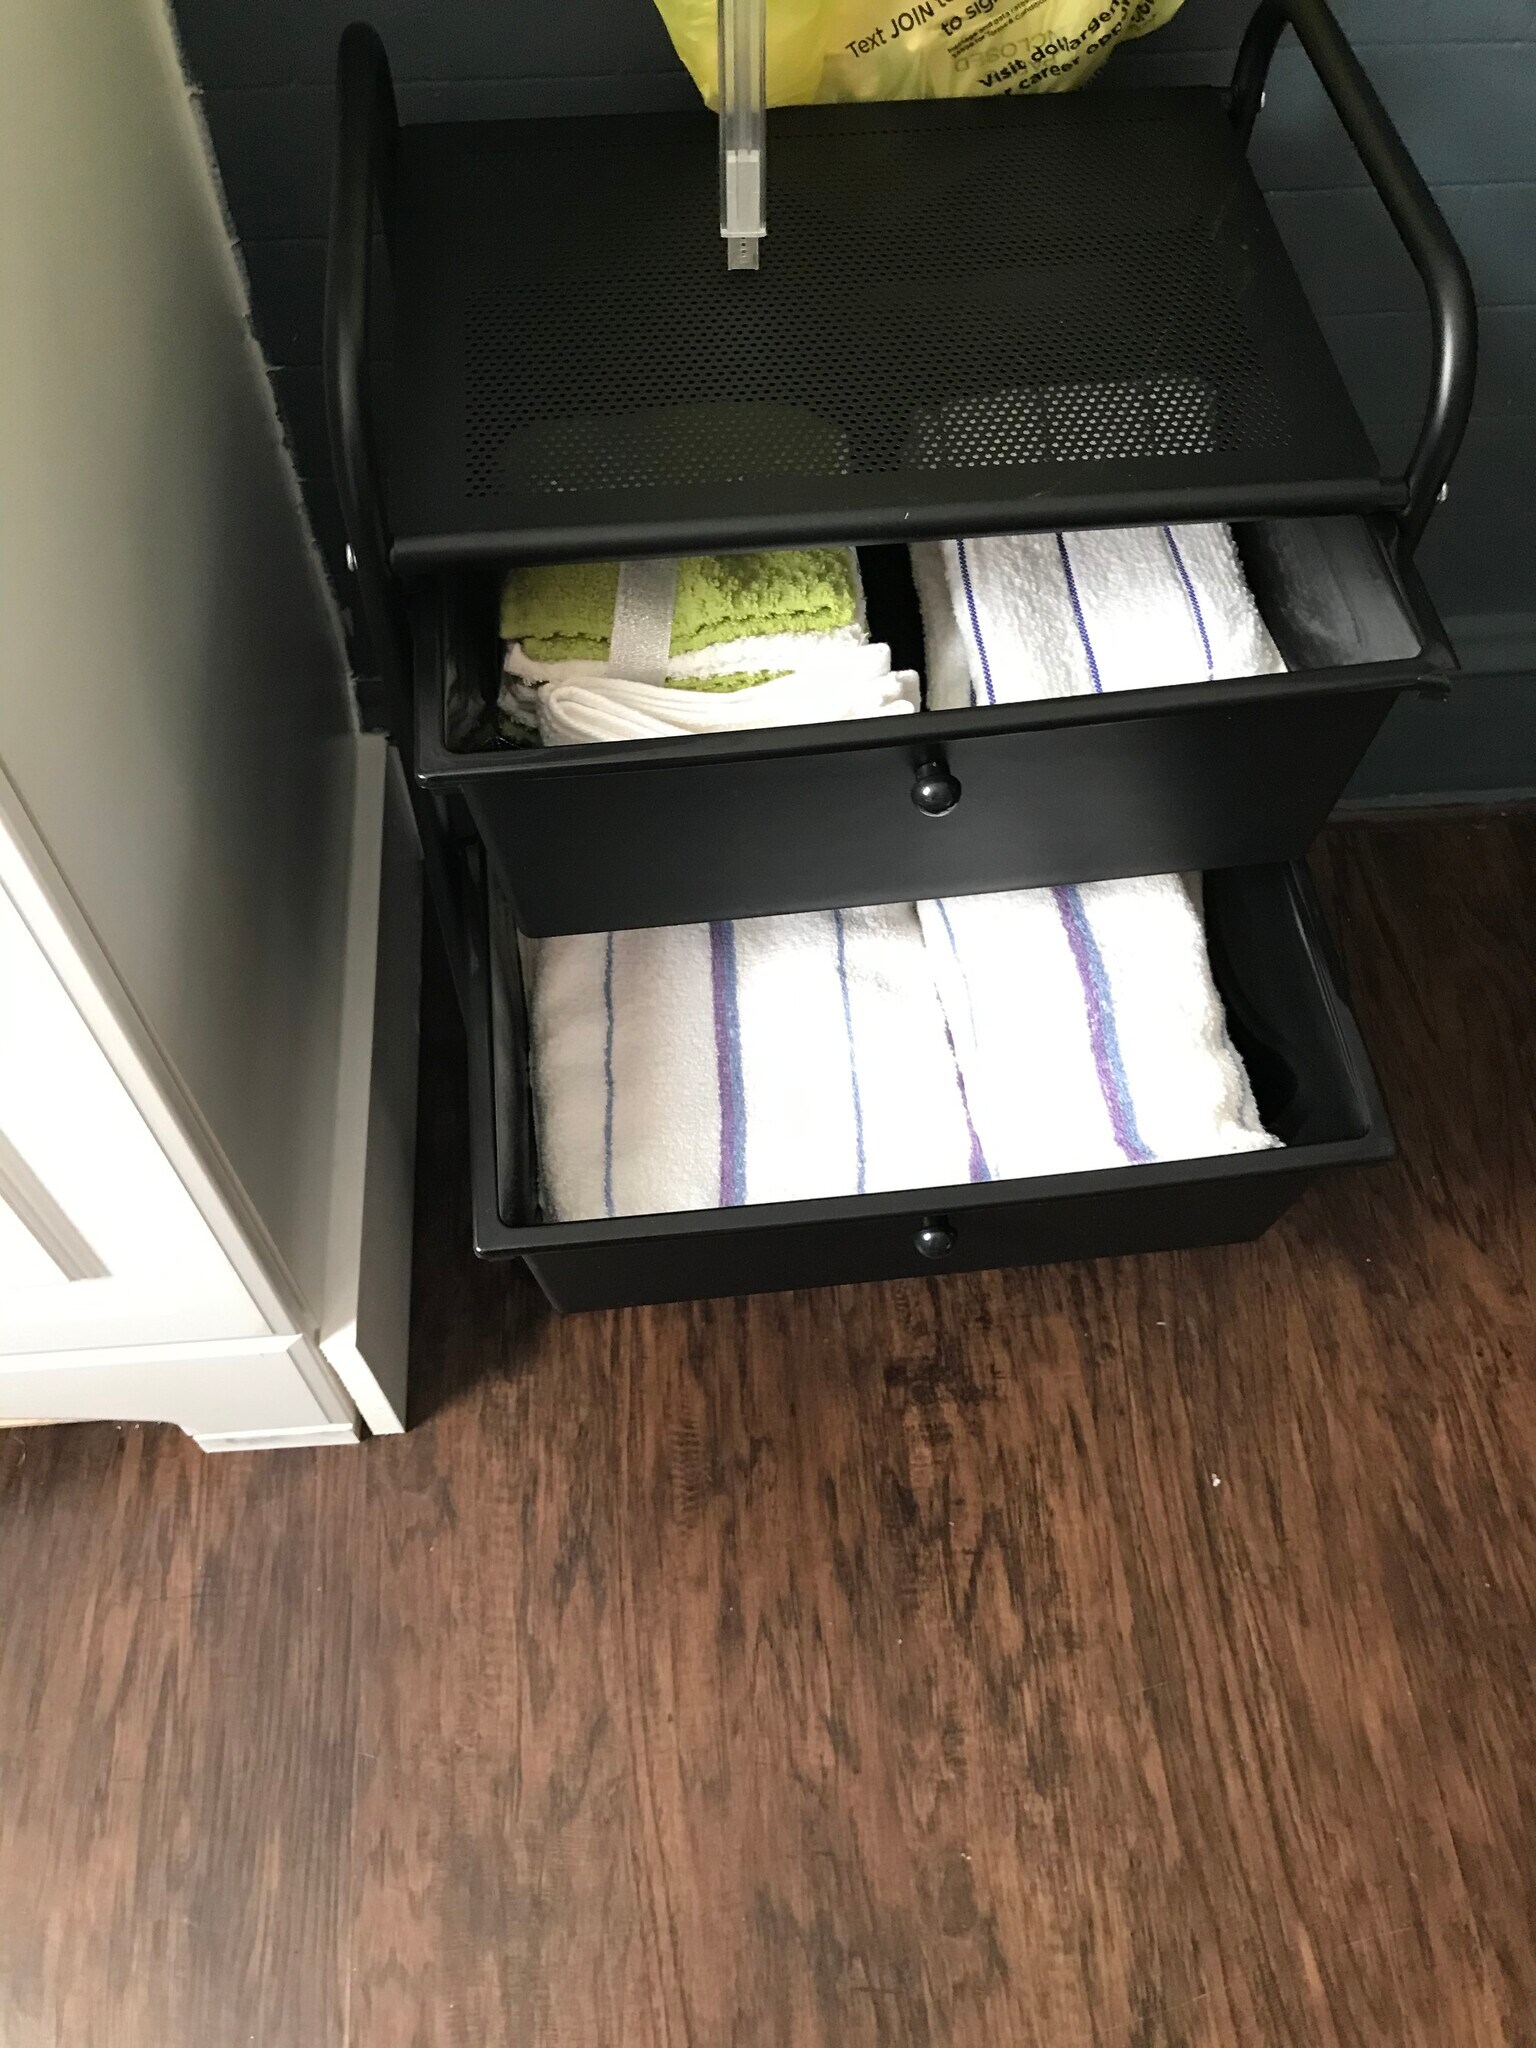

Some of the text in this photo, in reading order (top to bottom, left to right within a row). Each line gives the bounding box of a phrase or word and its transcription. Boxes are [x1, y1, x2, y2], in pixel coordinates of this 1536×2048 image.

[845, 27, 887, 58] Text
[891, 1, 935, 39] JOIN
[941, 0, 997, 36] to sig
[1019, 56, 1080, 90] career
